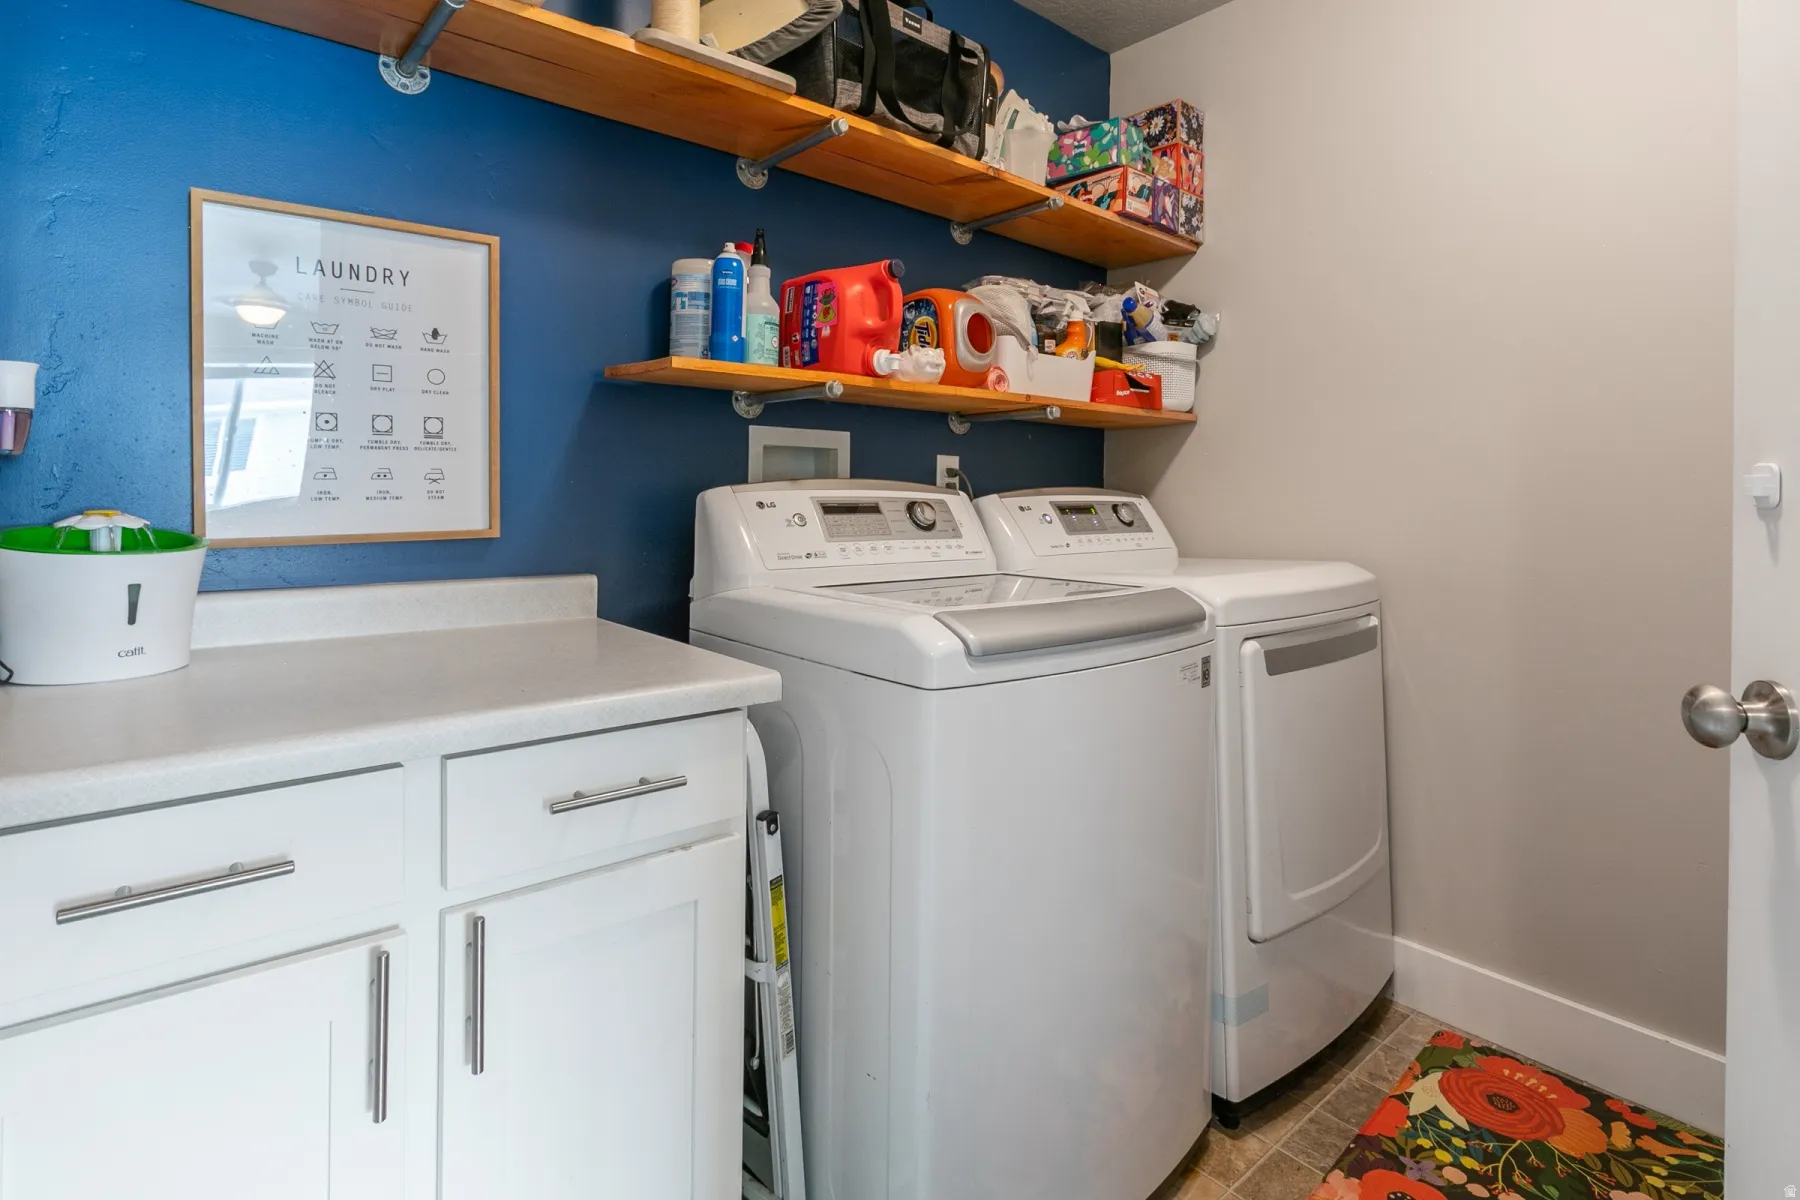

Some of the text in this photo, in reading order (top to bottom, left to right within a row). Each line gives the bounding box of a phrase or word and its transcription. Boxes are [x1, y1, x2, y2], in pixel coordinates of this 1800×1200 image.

[296, 256, 410, 287] LAUNDRY
[297, 293, 413, 313] CARE SYMBOL GUIDE
[251, 332, 279, 340] MACHINE
